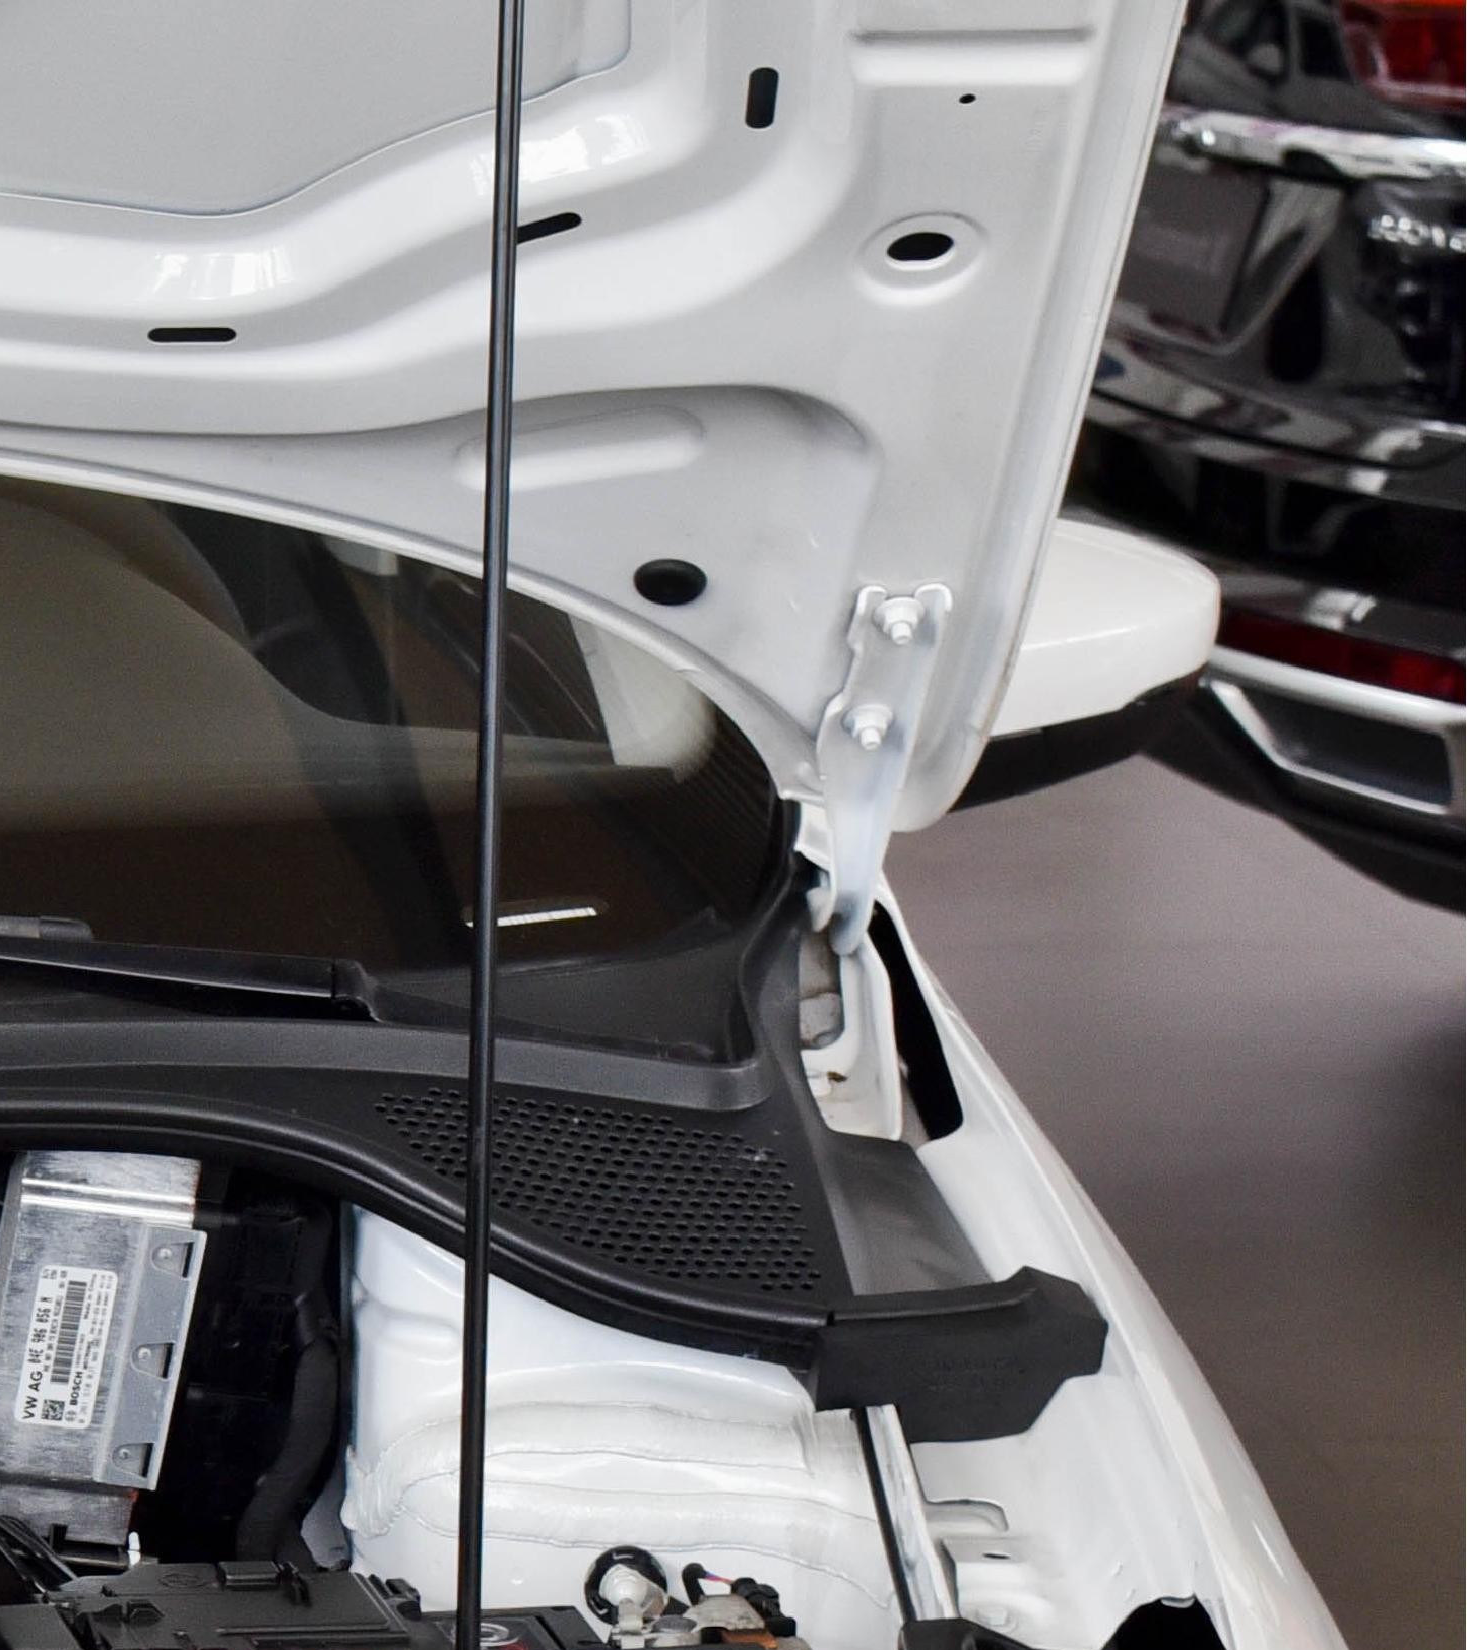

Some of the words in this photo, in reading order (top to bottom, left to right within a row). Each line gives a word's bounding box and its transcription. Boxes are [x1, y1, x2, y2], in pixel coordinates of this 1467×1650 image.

[28, 1371, 43, 1392] AG
[69, 1371, 83, 1405] BOSCH
[22, 1396, 39, 1419] VW
